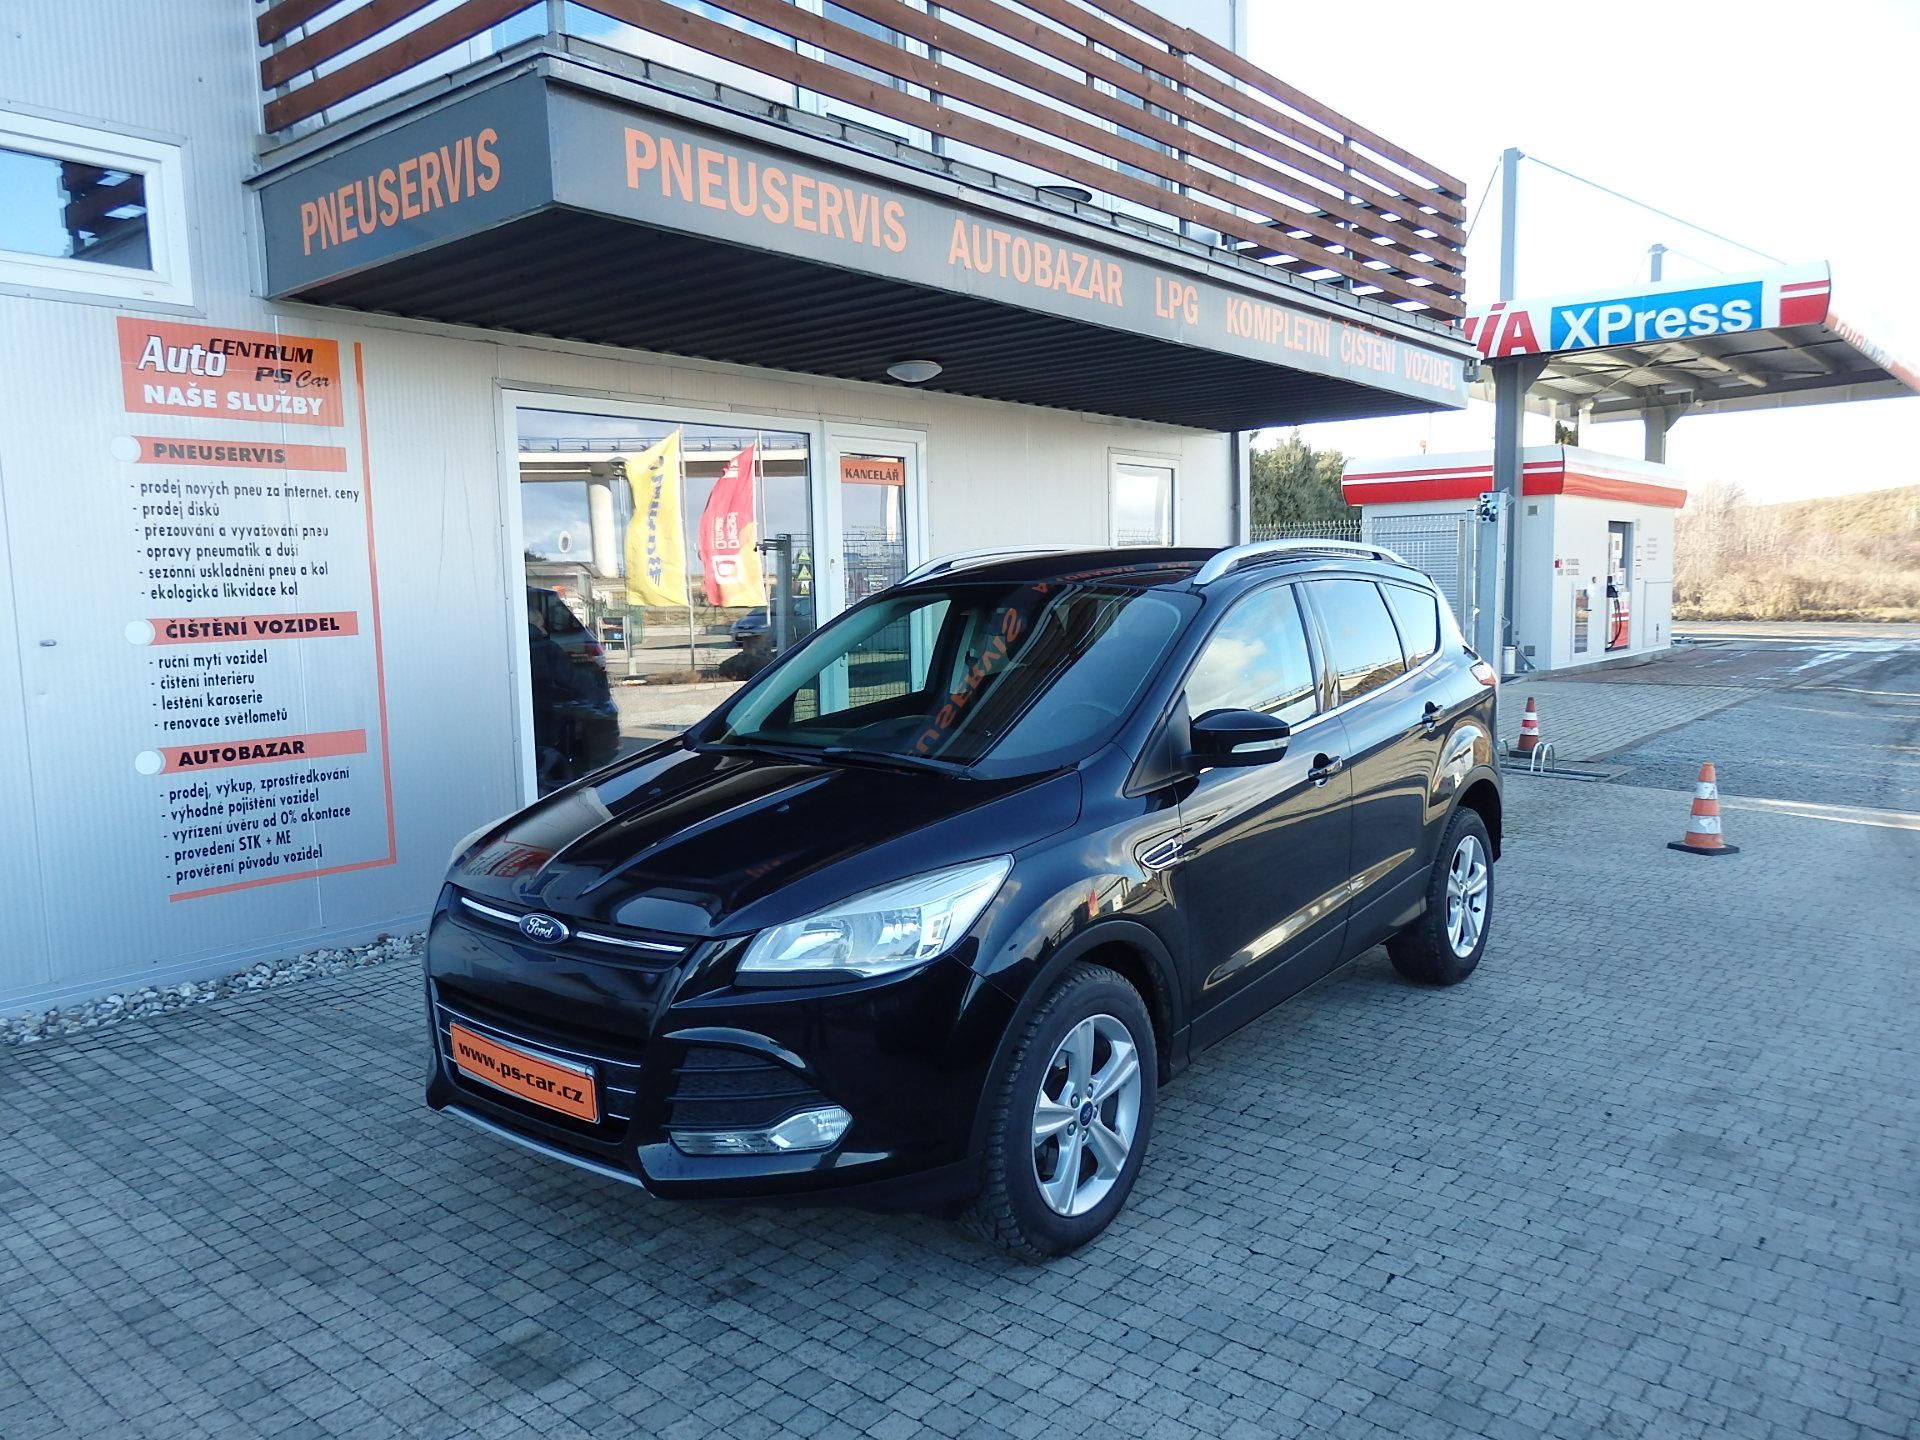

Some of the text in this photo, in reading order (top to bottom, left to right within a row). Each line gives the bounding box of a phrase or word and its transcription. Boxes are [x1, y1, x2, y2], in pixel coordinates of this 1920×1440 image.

[300, 128, 501, 256] PNEUSERVIS
[624, 127, 1457, 390] PNEUSERVIS AUTOBAZAR LPG KOMPLETNÍ ČIŠTĚNÍ VOZIDEL
[1556, 298, 1753, 351] XPress
[137, 335, 314, 377] Auto CENTRUM
[255, 366, 330, 388] PS Car
[143, 383, 323, 416] NAŠE SLUŽBY
[153, 443, 286, 464] PNEUSERVIS
[845, 467, 899, 481] KANCELÁŘ
[140, 480, 181, 498] prodej
[186, 481, 230, 498] nových
[234, 486, 262, 499] pneu
[267, 487, 280, 496] za
[335, 491, 360, 502] ceny
[142, 502, 183, 519] prodej
[219, 526, 226, 536] a
[302, 527, 329, 540] pneu
[147, 547, 191, 561] opravy
[196, 542, 261, 560] pneumatik
[265, 547, 272, 557] a
[269, 567, 296, 580] pneu
[301, 566, 307, 576] a
[312, 561, 329, 576] kol
[223, 582, 276, 598] likvidace
[280, 581, 298, 597] kol
[166, 617, 340, 639] ČIŠTĚNÍ VOZIDEL
[226, 649, 268, 665] vozidel
[207, 690, 263, 707] karoserie
[164, 717, 220, 731] renovace
[179, 740, 305, 767] AUTOBAZAR
[169, 781, 212, 805] prodej,
[280, 788, 320, 806] vozidel
[263, 812, 277, 828] od
[281, 810, 298, 825] 0%
[301, 804, 351, 823] akontace
[239, 833, 262, 852] STK
[276, 830, 291, 845] ME
[283, 843, 323, 863] vozidel
[526, 917, 553, 939] Ford
[459, 1042, 585, 1105] www.ps-car.cz
